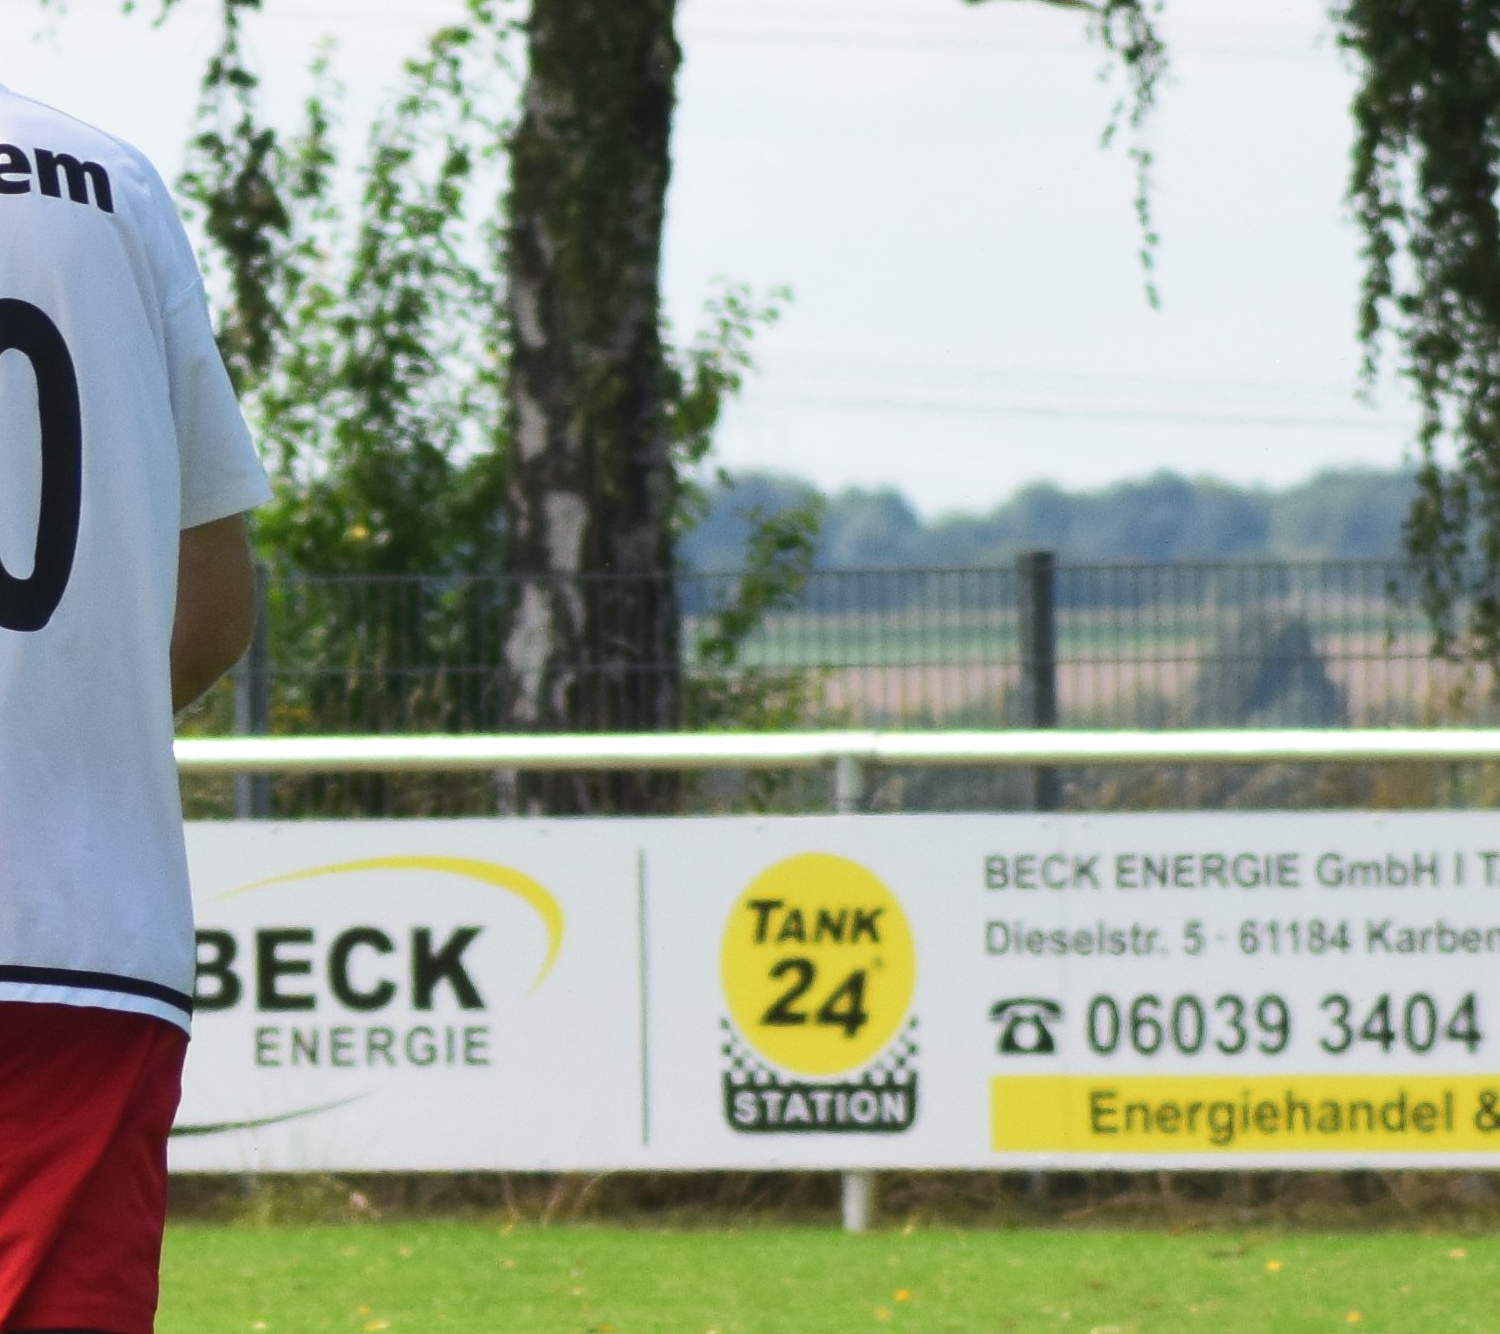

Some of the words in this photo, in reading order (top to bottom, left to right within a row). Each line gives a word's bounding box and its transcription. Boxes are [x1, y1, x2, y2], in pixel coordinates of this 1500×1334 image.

[984, 853, 1100, 890] BECK
[1115, 853, 1301, 889] ENERGIE
[1315, 852, 1440, 889] GmbH
[1477, 852, 1500, 887] T
[748, 898, 885, 945] TANK
[984, 919, 1168, 956] Dieselstr.
[1183, 919, 1205, 956] 5
[1239, 919, 1351, 956] 61184
[191, 925, 487, 1013] BECK
[760, 956, 869, 1040] 24
[254, 1025, 490, 1067] ENERGIE
[1086, 992, 1292, 1057] 06039
[1319, 991, 1483, 1055] 3404
[733, 1090, 908, 1126] STATION
[1089, 1089, 1455, 1146] Energiehandel
